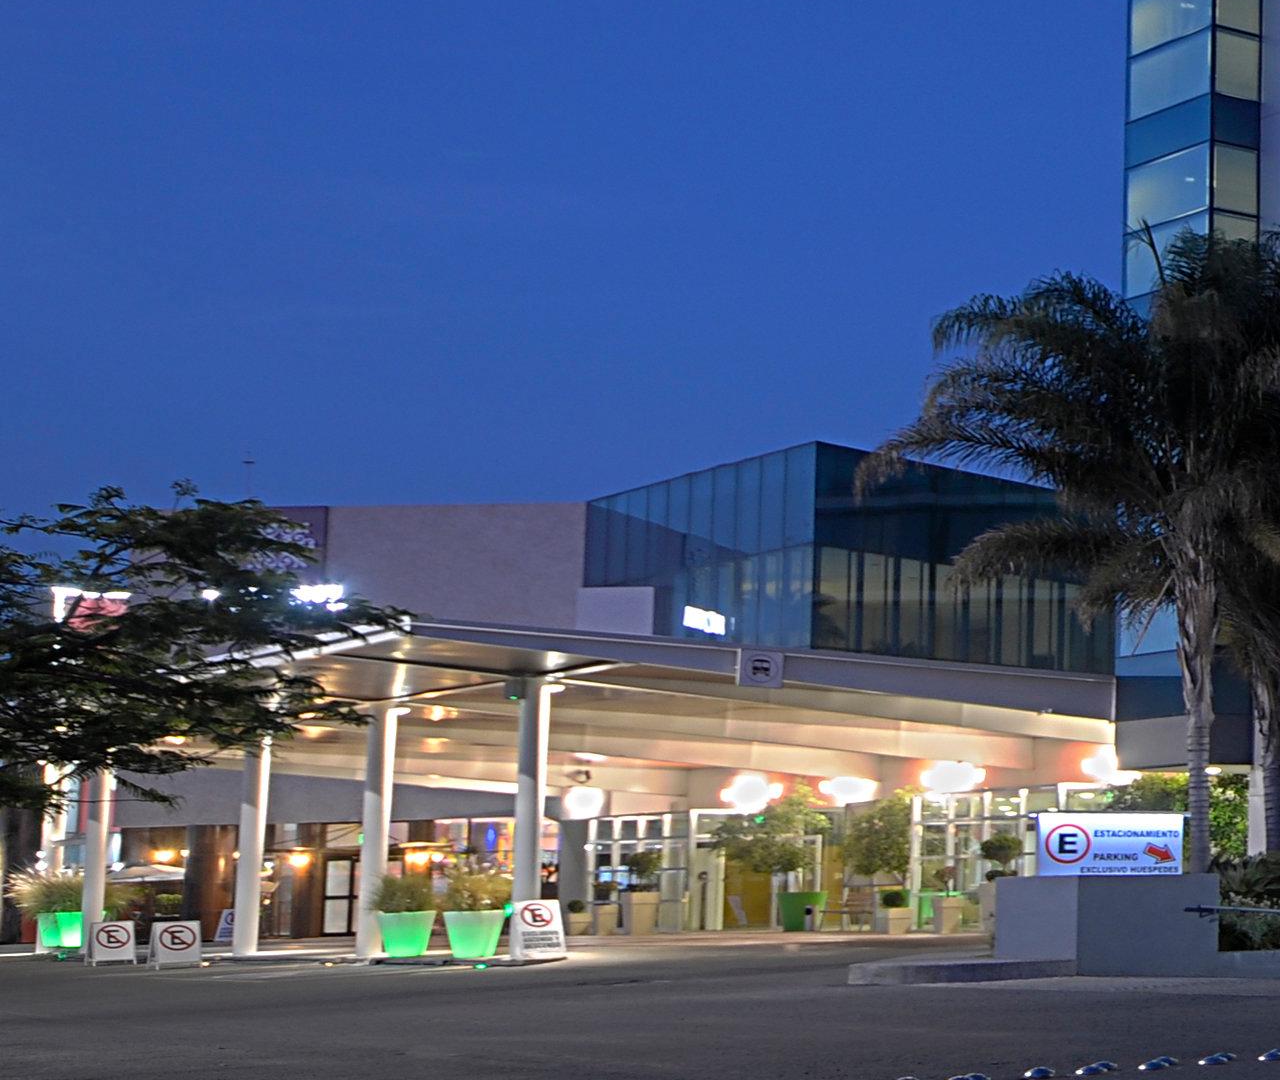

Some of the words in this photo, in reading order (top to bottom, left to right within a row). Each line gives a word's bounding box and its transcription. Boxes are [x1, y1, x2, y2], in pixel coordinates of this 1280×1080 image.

[1093, 830, 1180, 838] ESTACIONAMIENTO
[1057, 833, 1079, 855] E
[1093, 853, 1139, 861] PARKING
[1080, 866, 1128, 874] EXCLUSIVO
[1130, 866, 1179, 874] HUESPEDES
